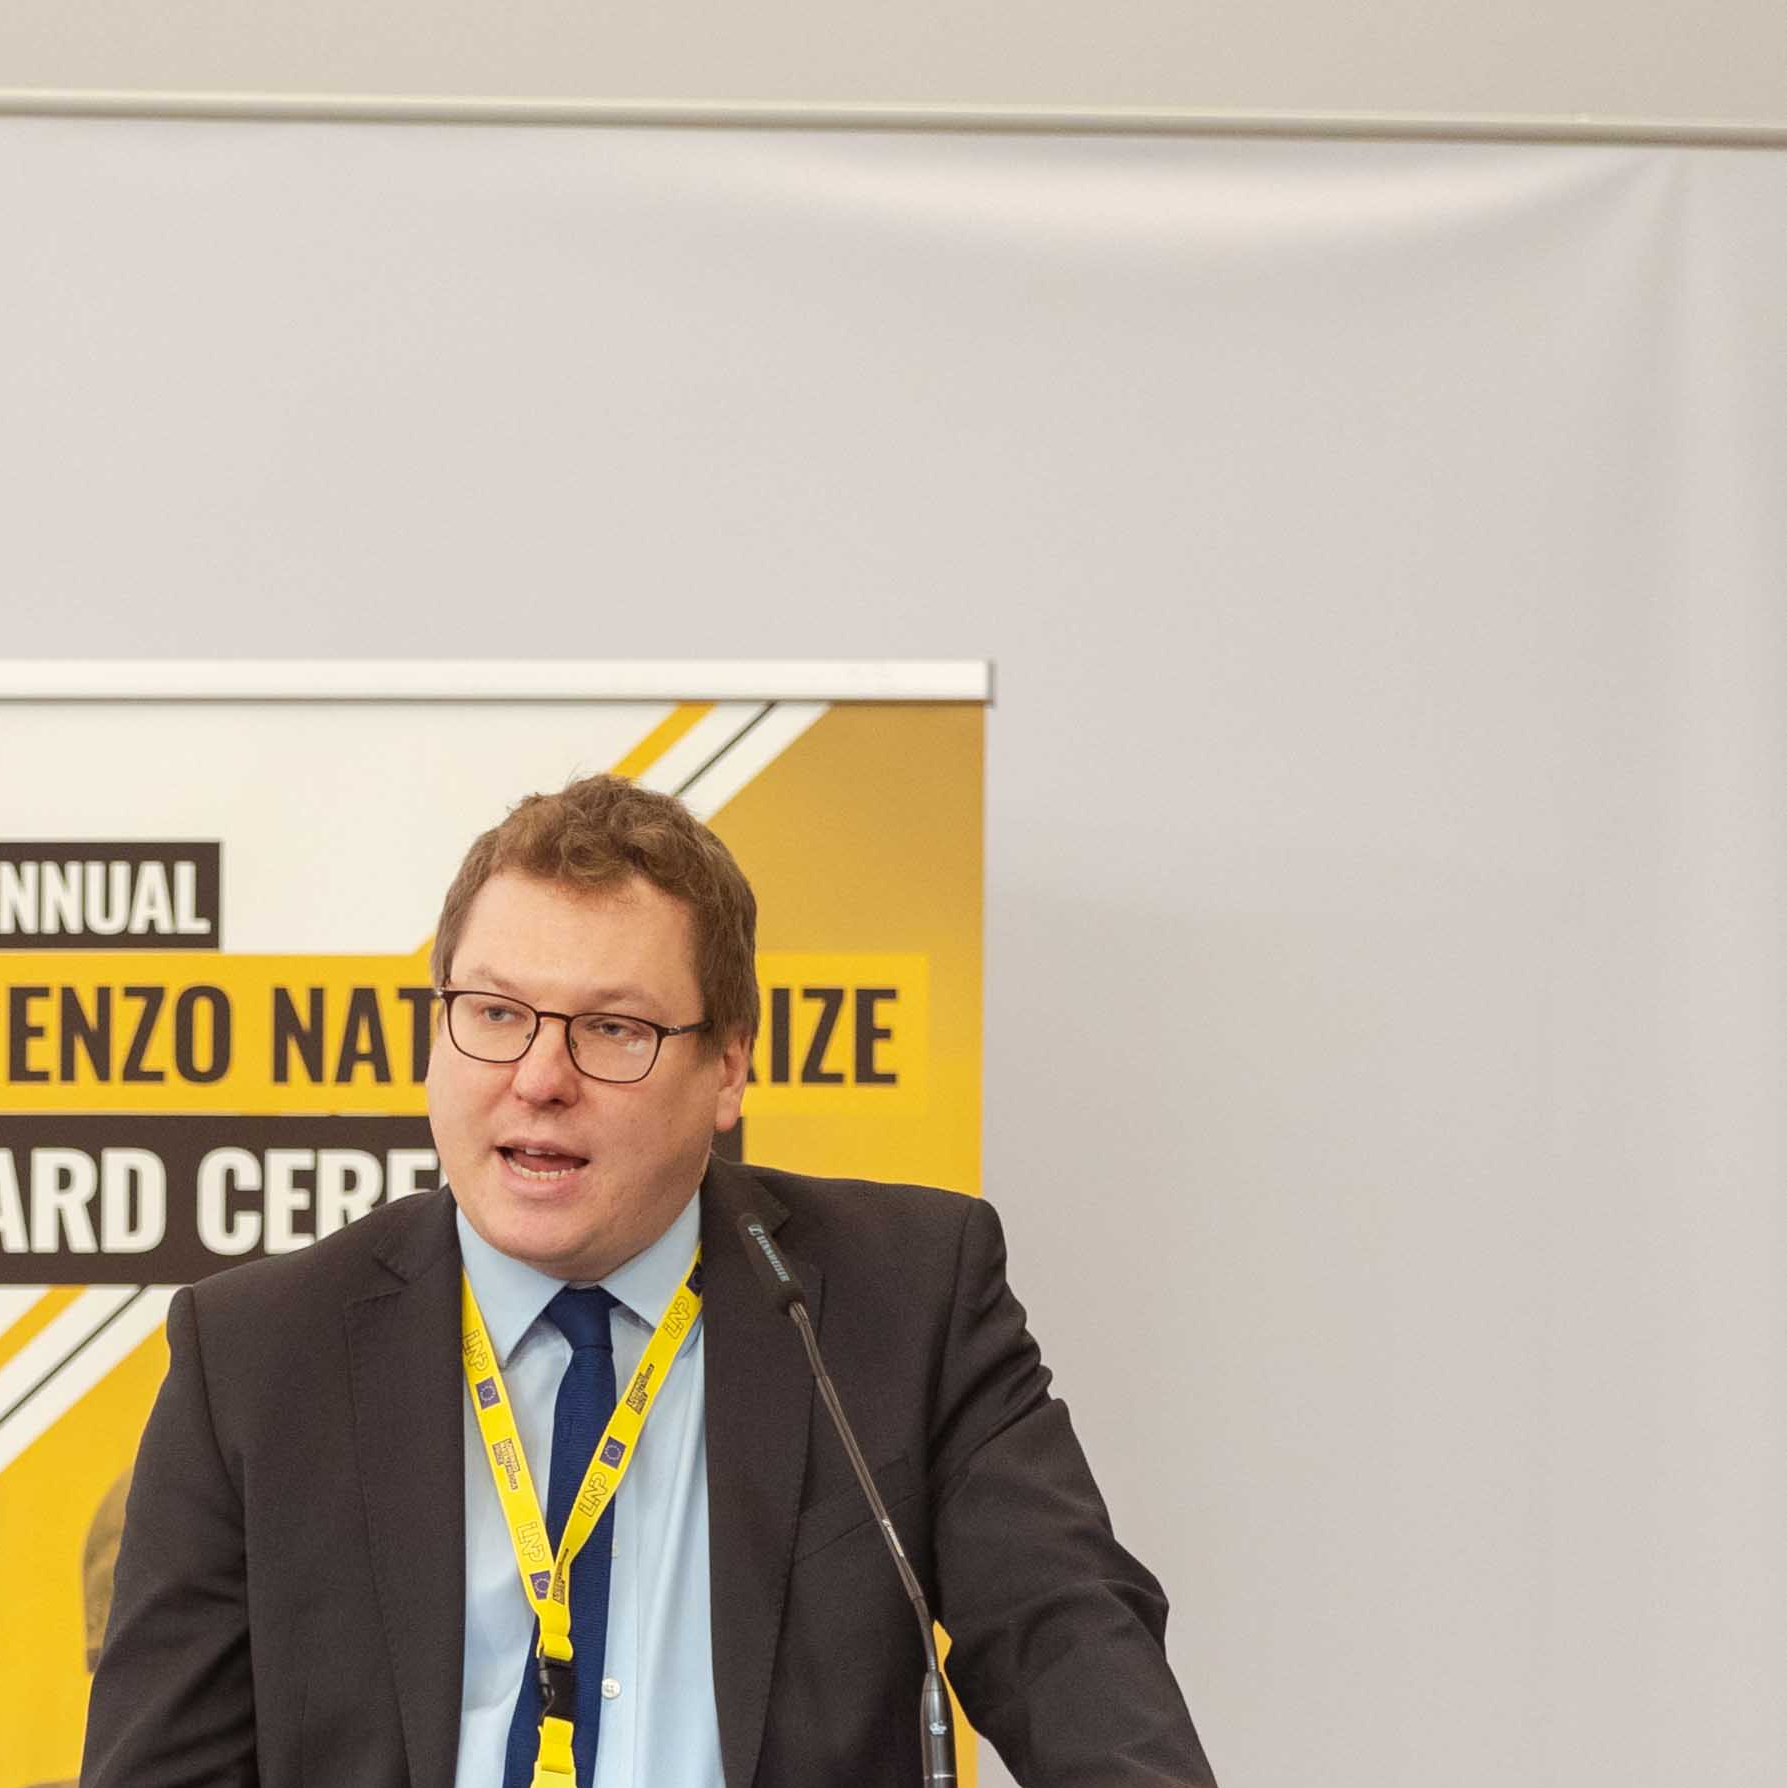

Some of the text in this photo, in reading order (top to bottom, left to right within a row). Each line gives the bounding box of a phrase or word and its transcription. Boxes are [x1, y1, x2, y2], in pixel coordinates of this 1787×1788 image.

[272, 985, 436, 1084] NAT
[747, 986, 898, 1084] IZE
[196, 1146, 450, 1255] CER
